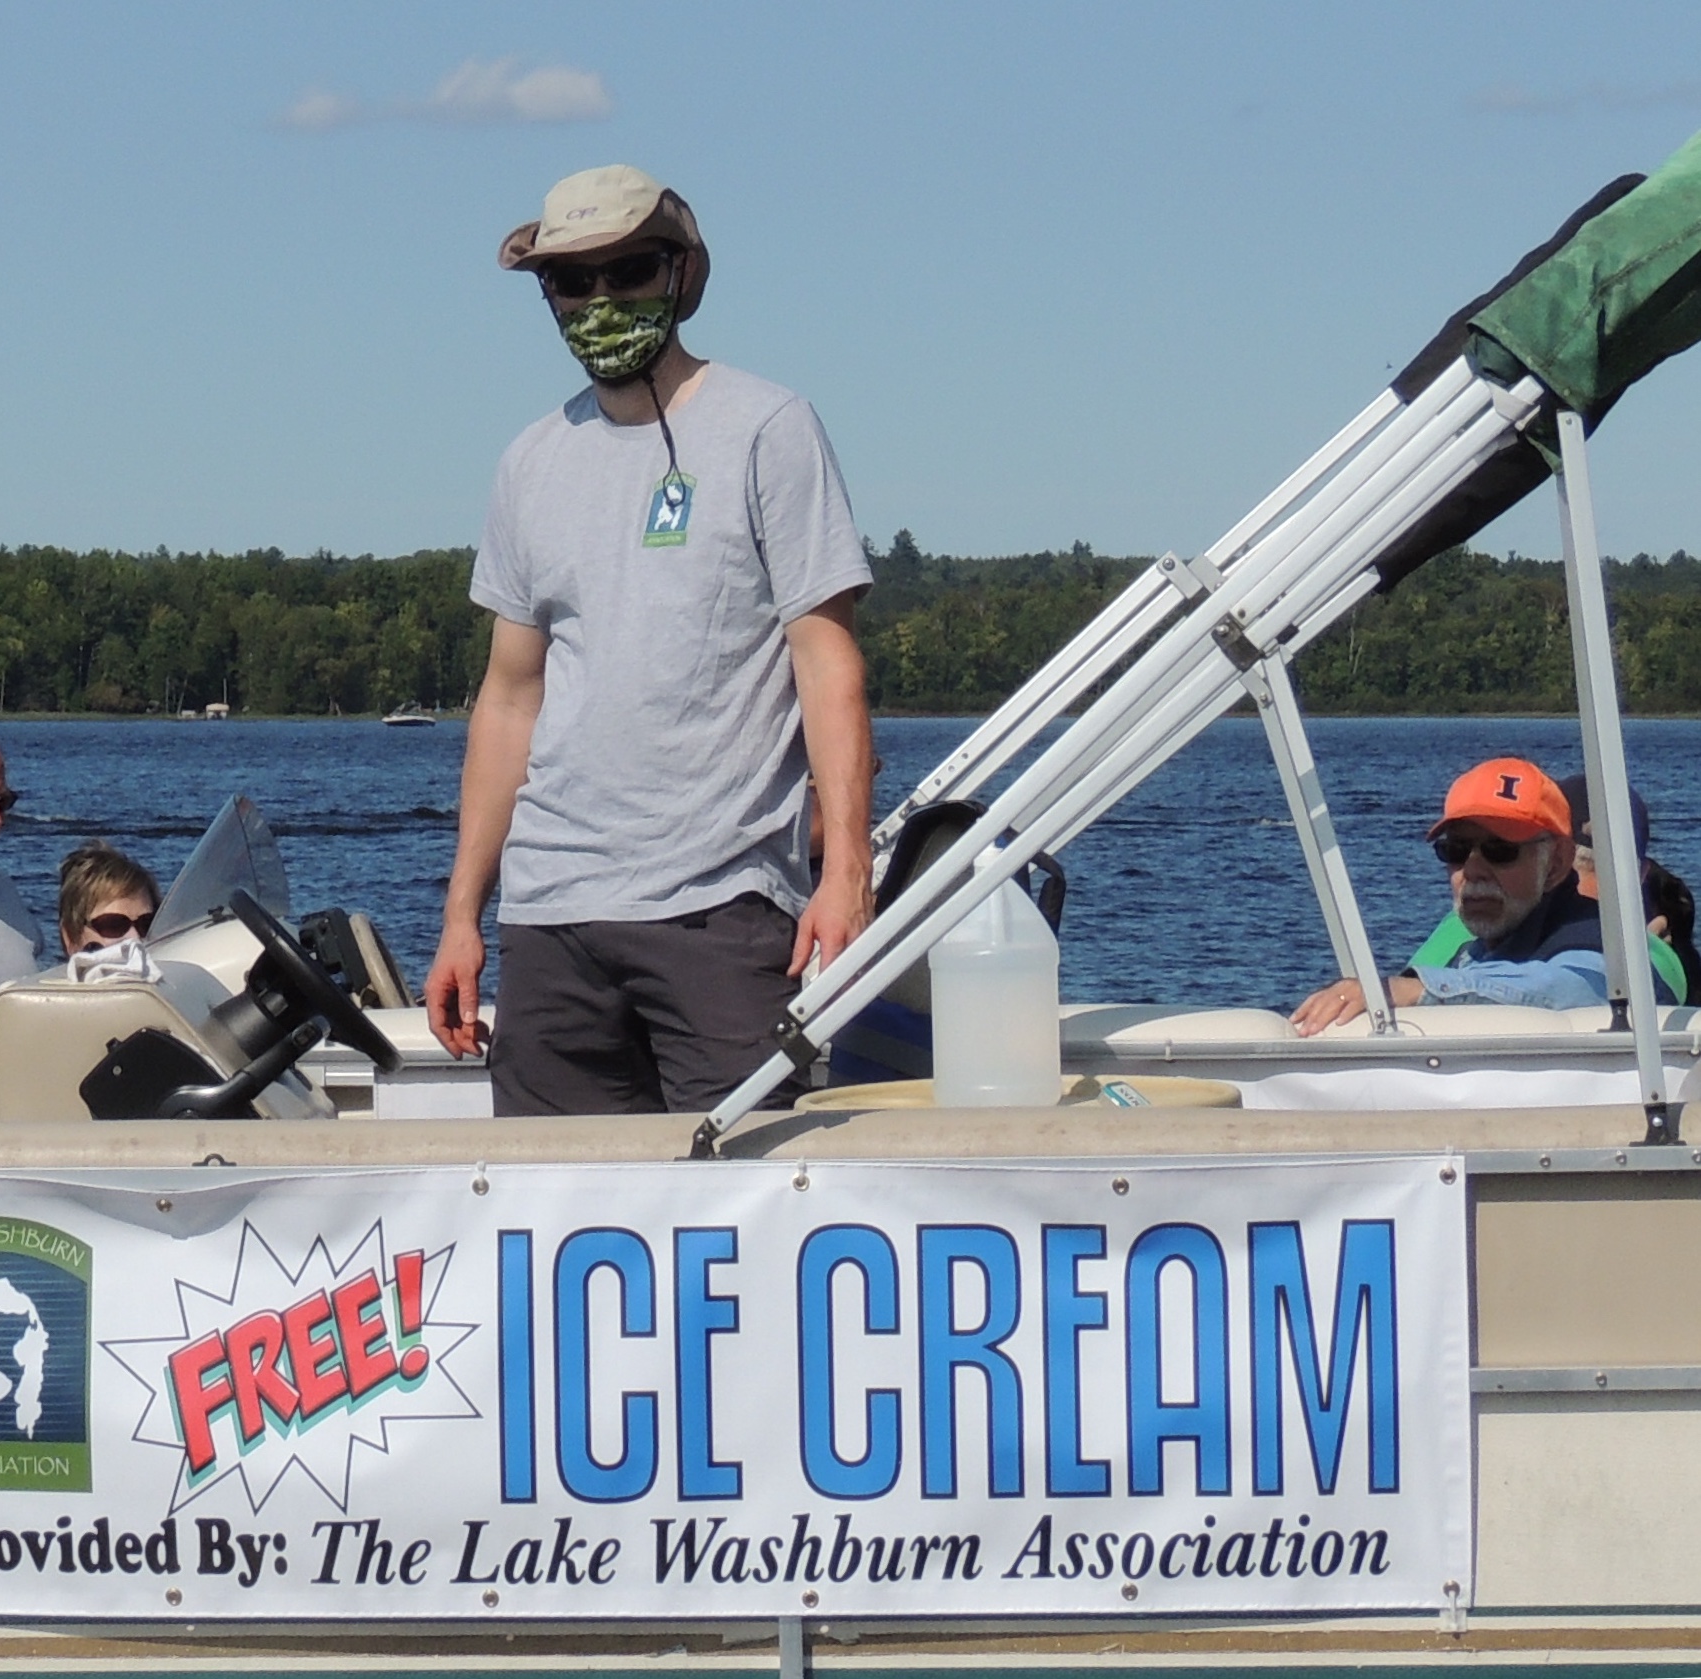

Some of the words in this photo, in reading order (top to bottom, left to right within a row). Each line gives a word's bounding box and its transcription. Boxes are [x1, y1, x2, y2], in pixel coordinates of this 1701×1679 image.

[1495, 774, 1522, 802] I
[166, 1248, 431, 1482] FREE!
[498, 1226, 744, 1504] ICE
[795, 1219, 1401, 1502] CREAM
[195, 1517, 288, 1588] By:
[311, 1519, 431, 1585] The
[449, 1517, 621, 1585] Lake
[650, 1514, 983, 1584] Washburn
[1001, 1514, 1391, 1580] Association
